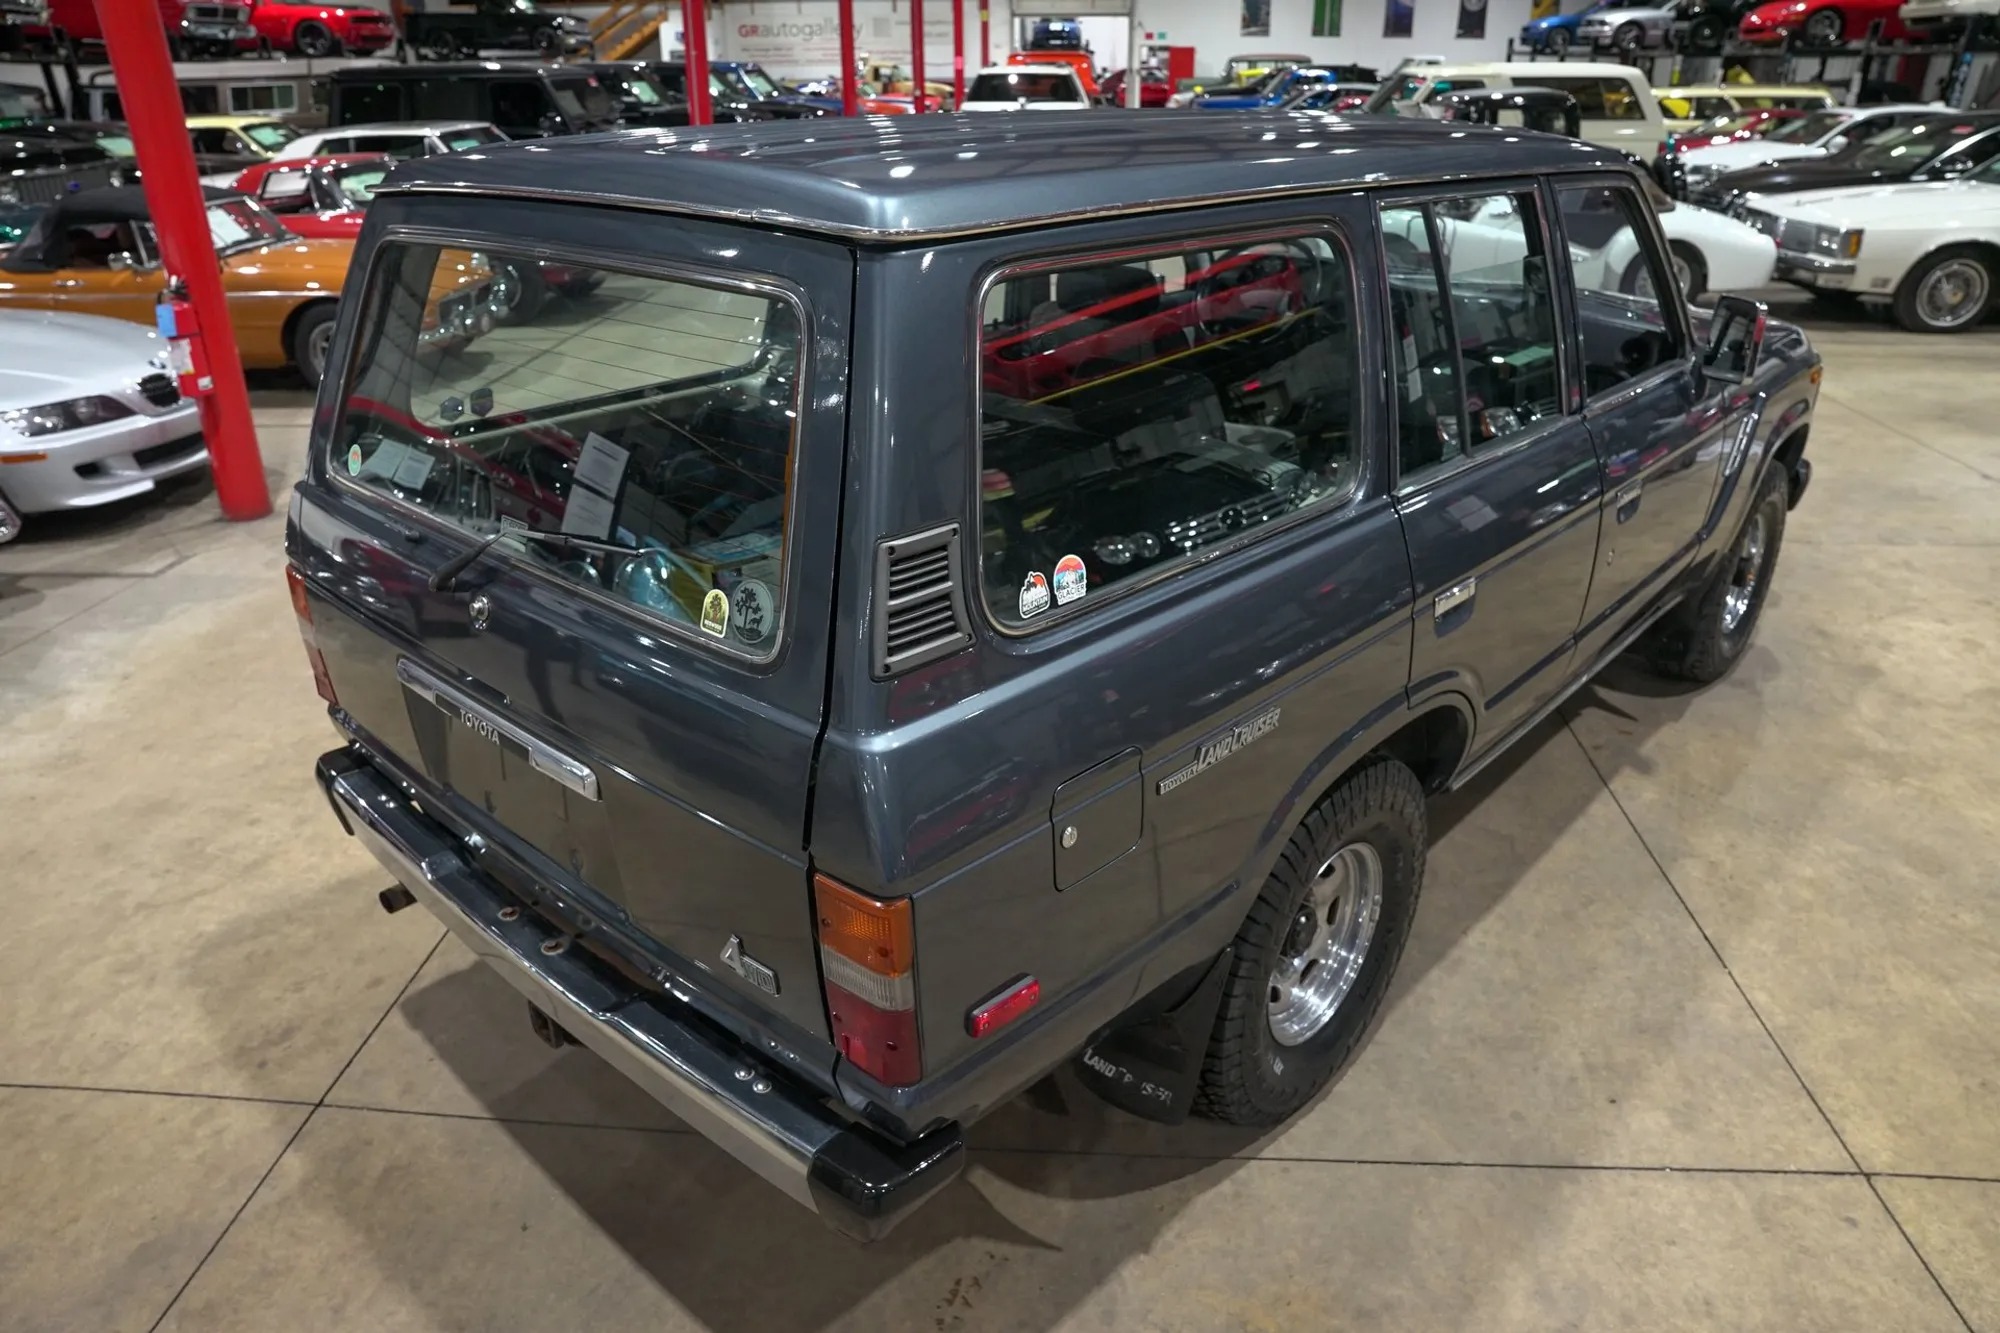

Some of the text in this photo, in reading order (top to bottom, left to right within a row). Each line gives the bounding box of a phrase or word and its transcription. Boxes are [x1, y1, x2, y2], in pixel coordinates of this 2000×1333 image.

[737, 17, 863, 41] GRautogalley
[1058, 583, 1085, 600] GLACIER
[460, 709, 500, 746] TOYOTA
[1161, 765, 1197, 793] TOYOTA
[1083, 1047, 1117, 1078] LAND
